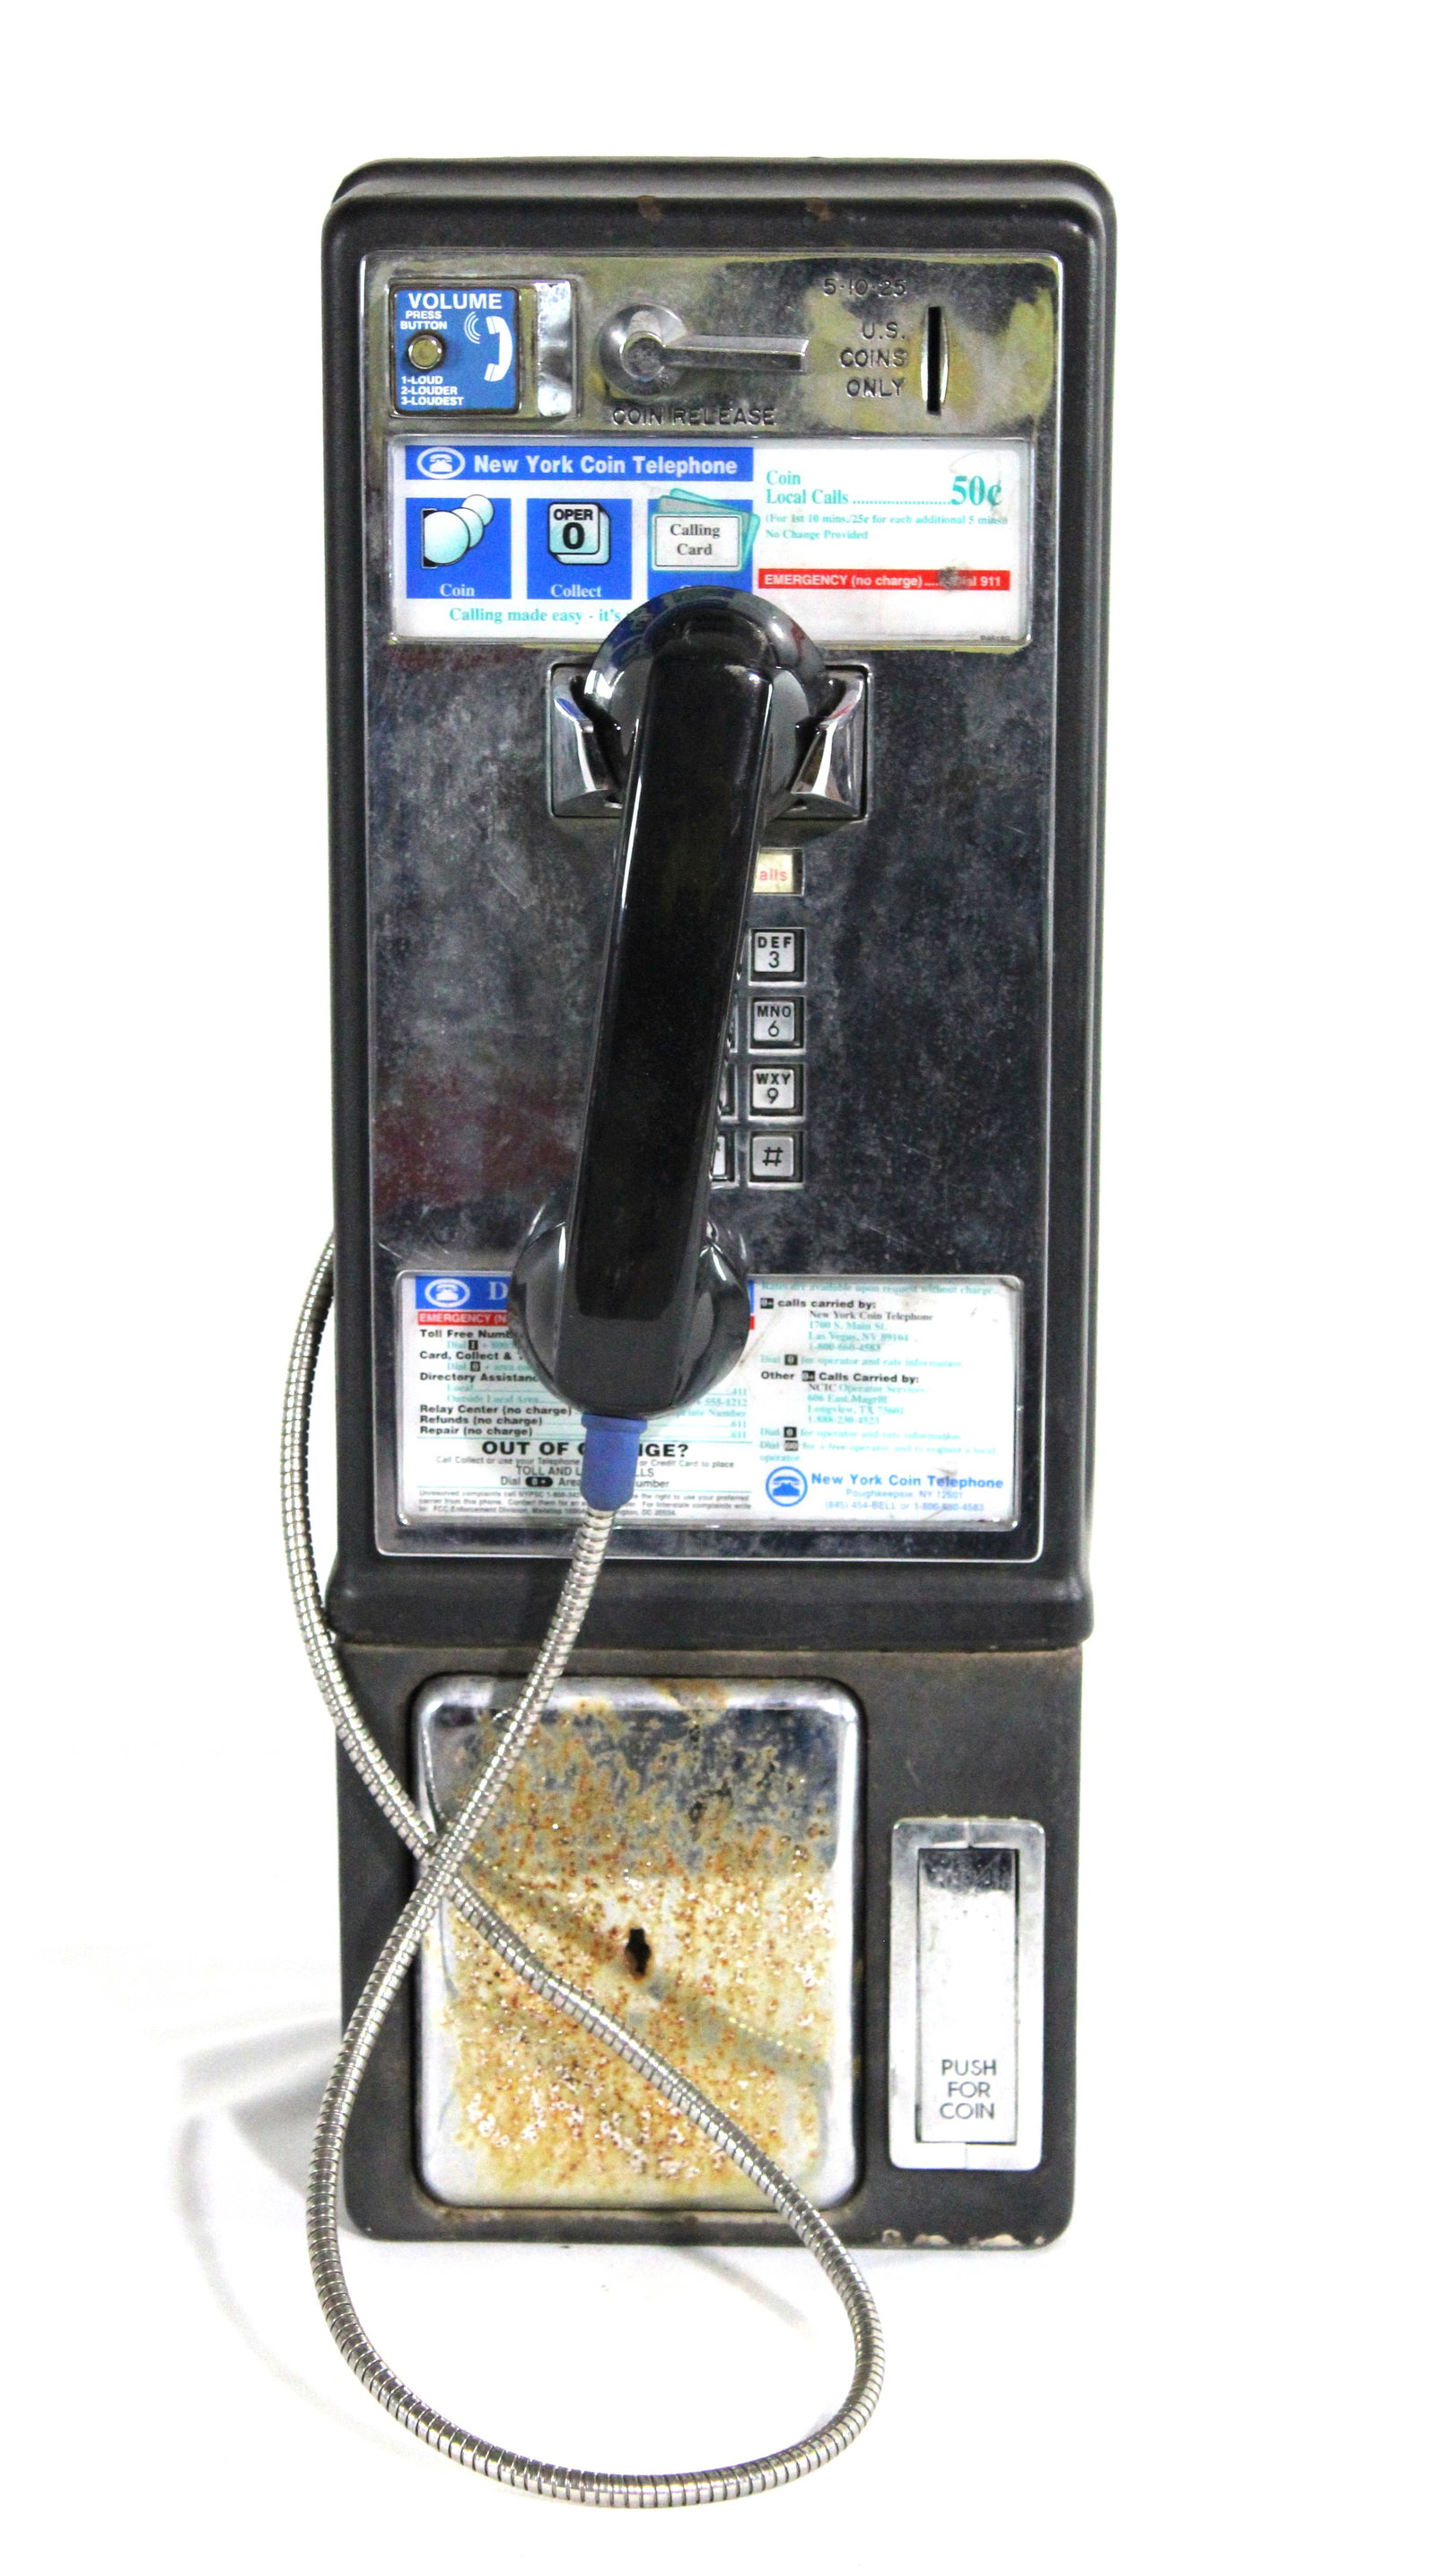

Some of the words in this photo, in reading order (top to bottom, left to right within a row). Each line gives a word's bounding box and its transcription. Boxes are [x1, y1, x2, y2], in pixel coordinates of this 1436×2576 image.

[408, 293, 503, 310] VOLUME
[406, 311, 442, 320] PRESS
[400, 320, 447, 330] BUTTON
[862, 322, 906, 339] U.S.
[840, 348, 909, 369] COINS
[401, 375, 443, 385] 1-LOUD
[401, 386, 458, 395] 2-LOUDER
[846, 378, 906, 398] ONLY
[401, 397, 464, 406] 3-LOUDEST
[612, 407, 662, 425] COIN
[672, 407, 776, 426] RELEASE
[474, 455, 517, 473] New
[526, 455, 573, 473] York
[581, 455, 626, 474] Coin
[633, 456, 738, 478] Telephone
[766, 470, 801, 486] Coin
[766, 489, 807, 504] Local
[811, 489, 849, 504] Calls
[553, 509, 593, 521] OPER
[809, 514, 819, 524] 10
[872, 514, 887, 525] for
[889, 514, 913, 525] each
[915, 514, 966, 525] additional
[969, 515, 975, 525] 5
[562, 522, 585, 550] 0
[670, 523, 721, 540] Calling
[766, 530, 780, 539] No
[783, 530, 820, 540] Change
[824, 530, 868, 539] Provided
[677, 543, 713, 556] Card
[765, 574, 848, 586] EMERGENCY
[852, 575, 872, 587] (no
[980, 576, 1001, 586] 911
[440, 583, 475, 597] Coin
[550, 583, 602, 598] Collect
[450, 608, 503, 623] Calling
[507, 609, 547, 621] made
[552, 610, 582, 625] easy
[757, 869, 788, 881] alls
[757, 936, 792, 950] DEF
[768, 951, 780, 968] 3
[757, 1005, 792, 1019] MNO
[768, 1021, 779, 1038] 6
[756, 1073, 791, 1085] WXY
[767, 1088, 779, 1104] 9
[763, 1146, 784, 1167] #
[778, 1299, 806, 1308] calls
[810, 1299, 854, 1309] carried
[858, 1300, 876, 1310] by:
[419, 1313, 491, 1323] EMERGENCY
[810, 1310, 828, 1319] New
[834, 1310, 854, 1319] York
[860, 1311, 882, 1320] Coin
[886, 1311, 933, 1322] Telephone
[420, 1329, 442, 1338] Toll
[447, 1329, 473, 1338] Free
[456, 1351, 499, 1361] Collect
[503, 1352, 512, 1361] &
[420, 1372, 476, 1383] Directory
[480, 1373, 538, 1383] Assistanc
[760, 1371, 794, 1380] Other
[819, 1372, 849, 1382] Calls
[854, 1373, 898, 1383] Carried
[902, 1374, 920, 1384] by:
[420, 1405, 453, 1415] Relay
[458, 1405, 498, 1415] Center
[502, 1406, 521, 1415] (no
[526, 1406, 573, 1416] charge)
[420, 1415, 468, 1424] Refunds
[473, 1415, 492, 1425] (no
[496, 1415, 543, 1426] charge)
[420, 1426, 460, 1436] Repair
[463, 1426, 483, 1436] (no
[486, 1426, 533, 1437] charge)
[482, 1441, 530, 1455] OUT
[539, 1441, 569, 1456] OF
[455, 1456, 485, 1465] Collect
[538, 1457, 580, 1468] Telephone
[517, 1467, 545, 1476] TOLL
[548, 1467, 576, 1476] AND
[501, 1476, 521, 1486] Dial
[635, 1476, 670, 1488] umber
[811, 1472, 843, 1485] New
[850, 1474, 882, 1486] York
[889, 1475, 922, 1487] Coin
[928, 1476, 1004, 1490] Telephone
[941, 2058, 997, 2076] PUSH
[948, 2081, 991, 2098] FOR
[940, 2102, 995, 2120] COIN
